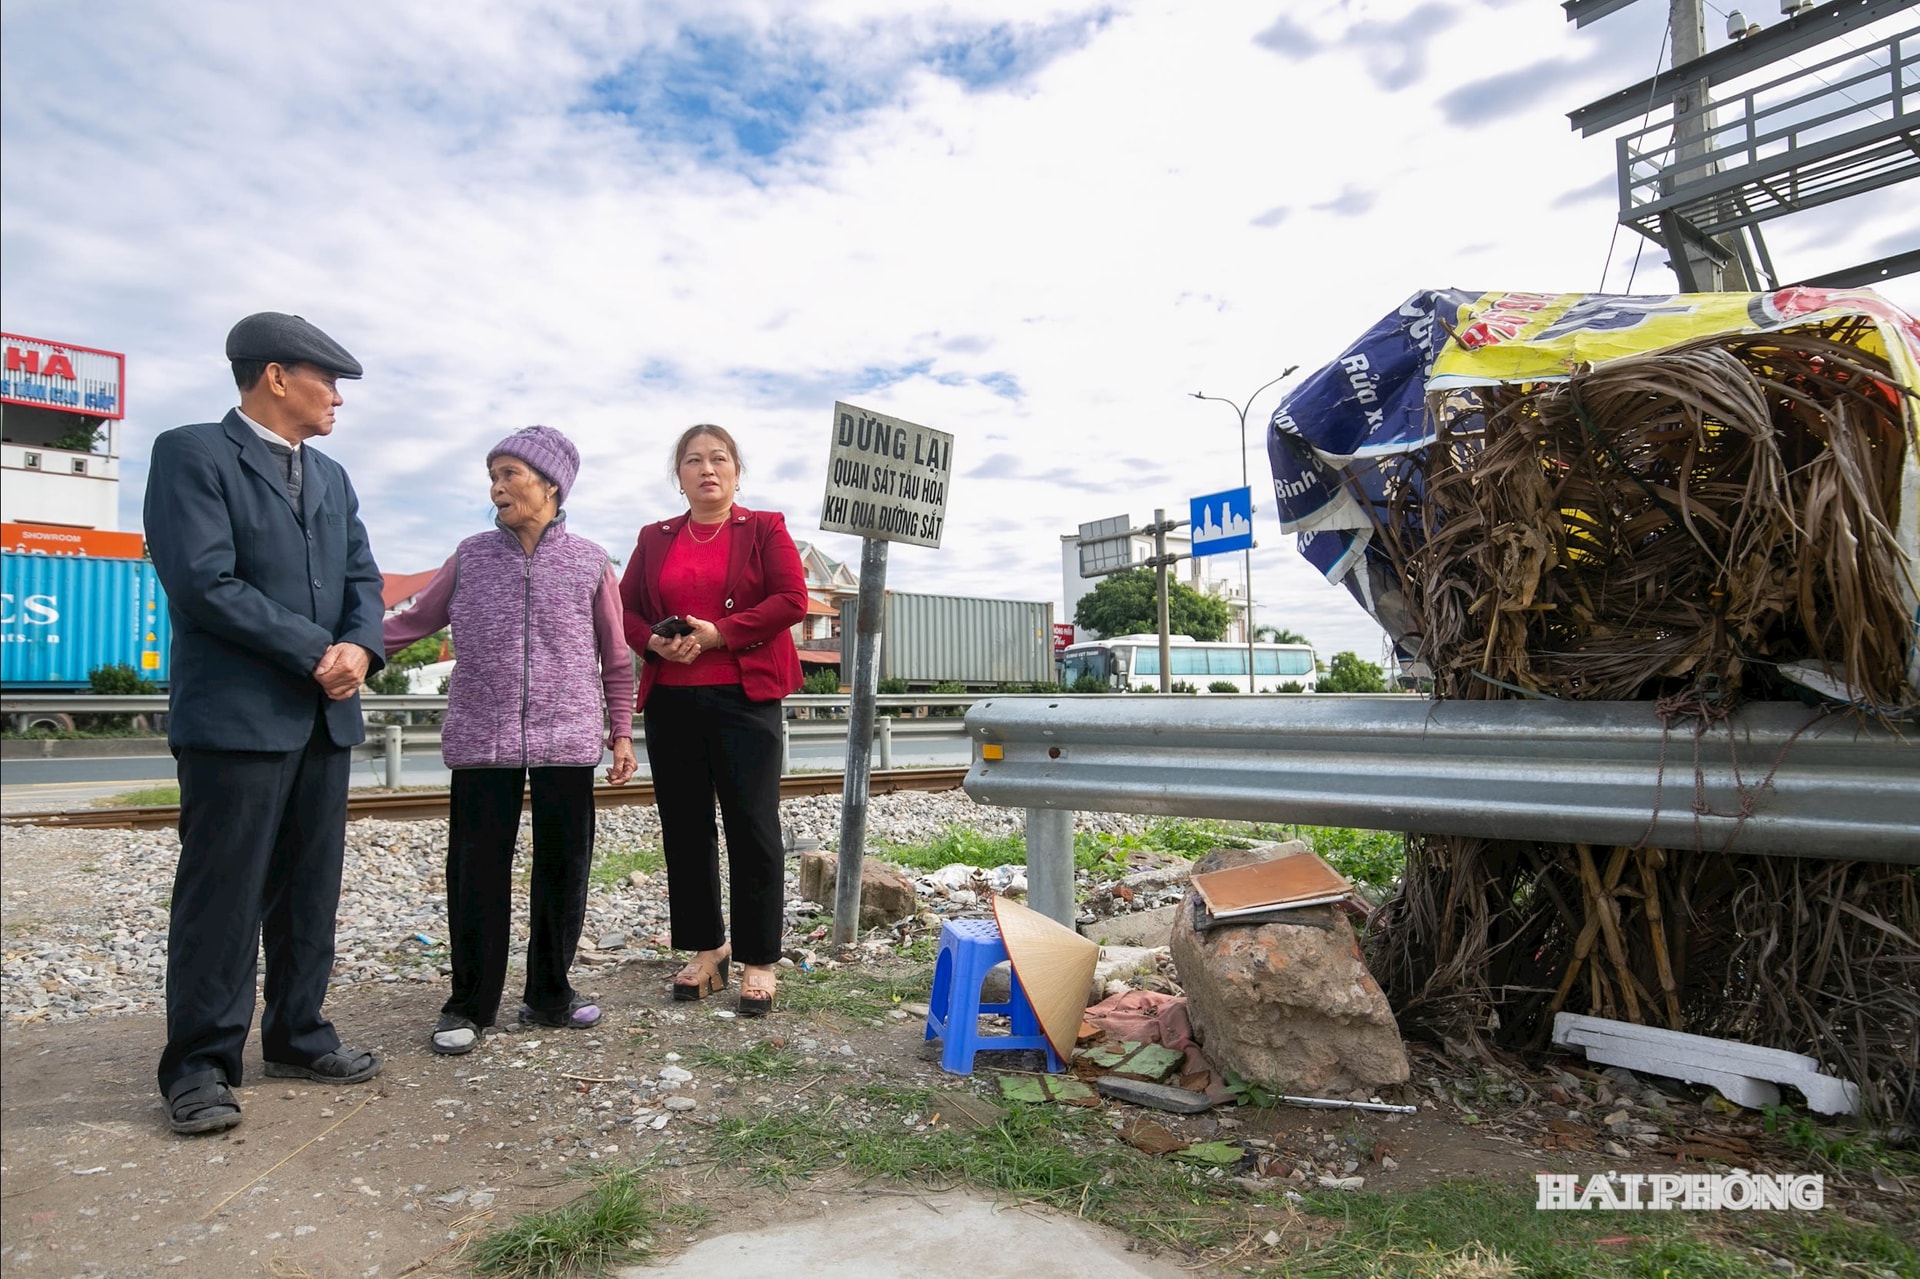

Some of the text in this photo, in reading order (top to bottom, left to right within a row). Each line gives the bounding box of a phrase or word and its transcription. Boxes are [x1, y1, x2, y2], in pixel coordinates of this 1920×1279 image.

[6, 347, 76, 381] HÀ
[838, 412, 949, 474] DỪNG LẠI
[834, 458, 943, 506] QUAN SÁT TÀU HỎA
[1274, 470, 1317, 499] Bình
[22, 531, 82, 543] SHOWROOM
[824, 495, 943, 540] KHI QUA ĐƯỜNG SẮT
